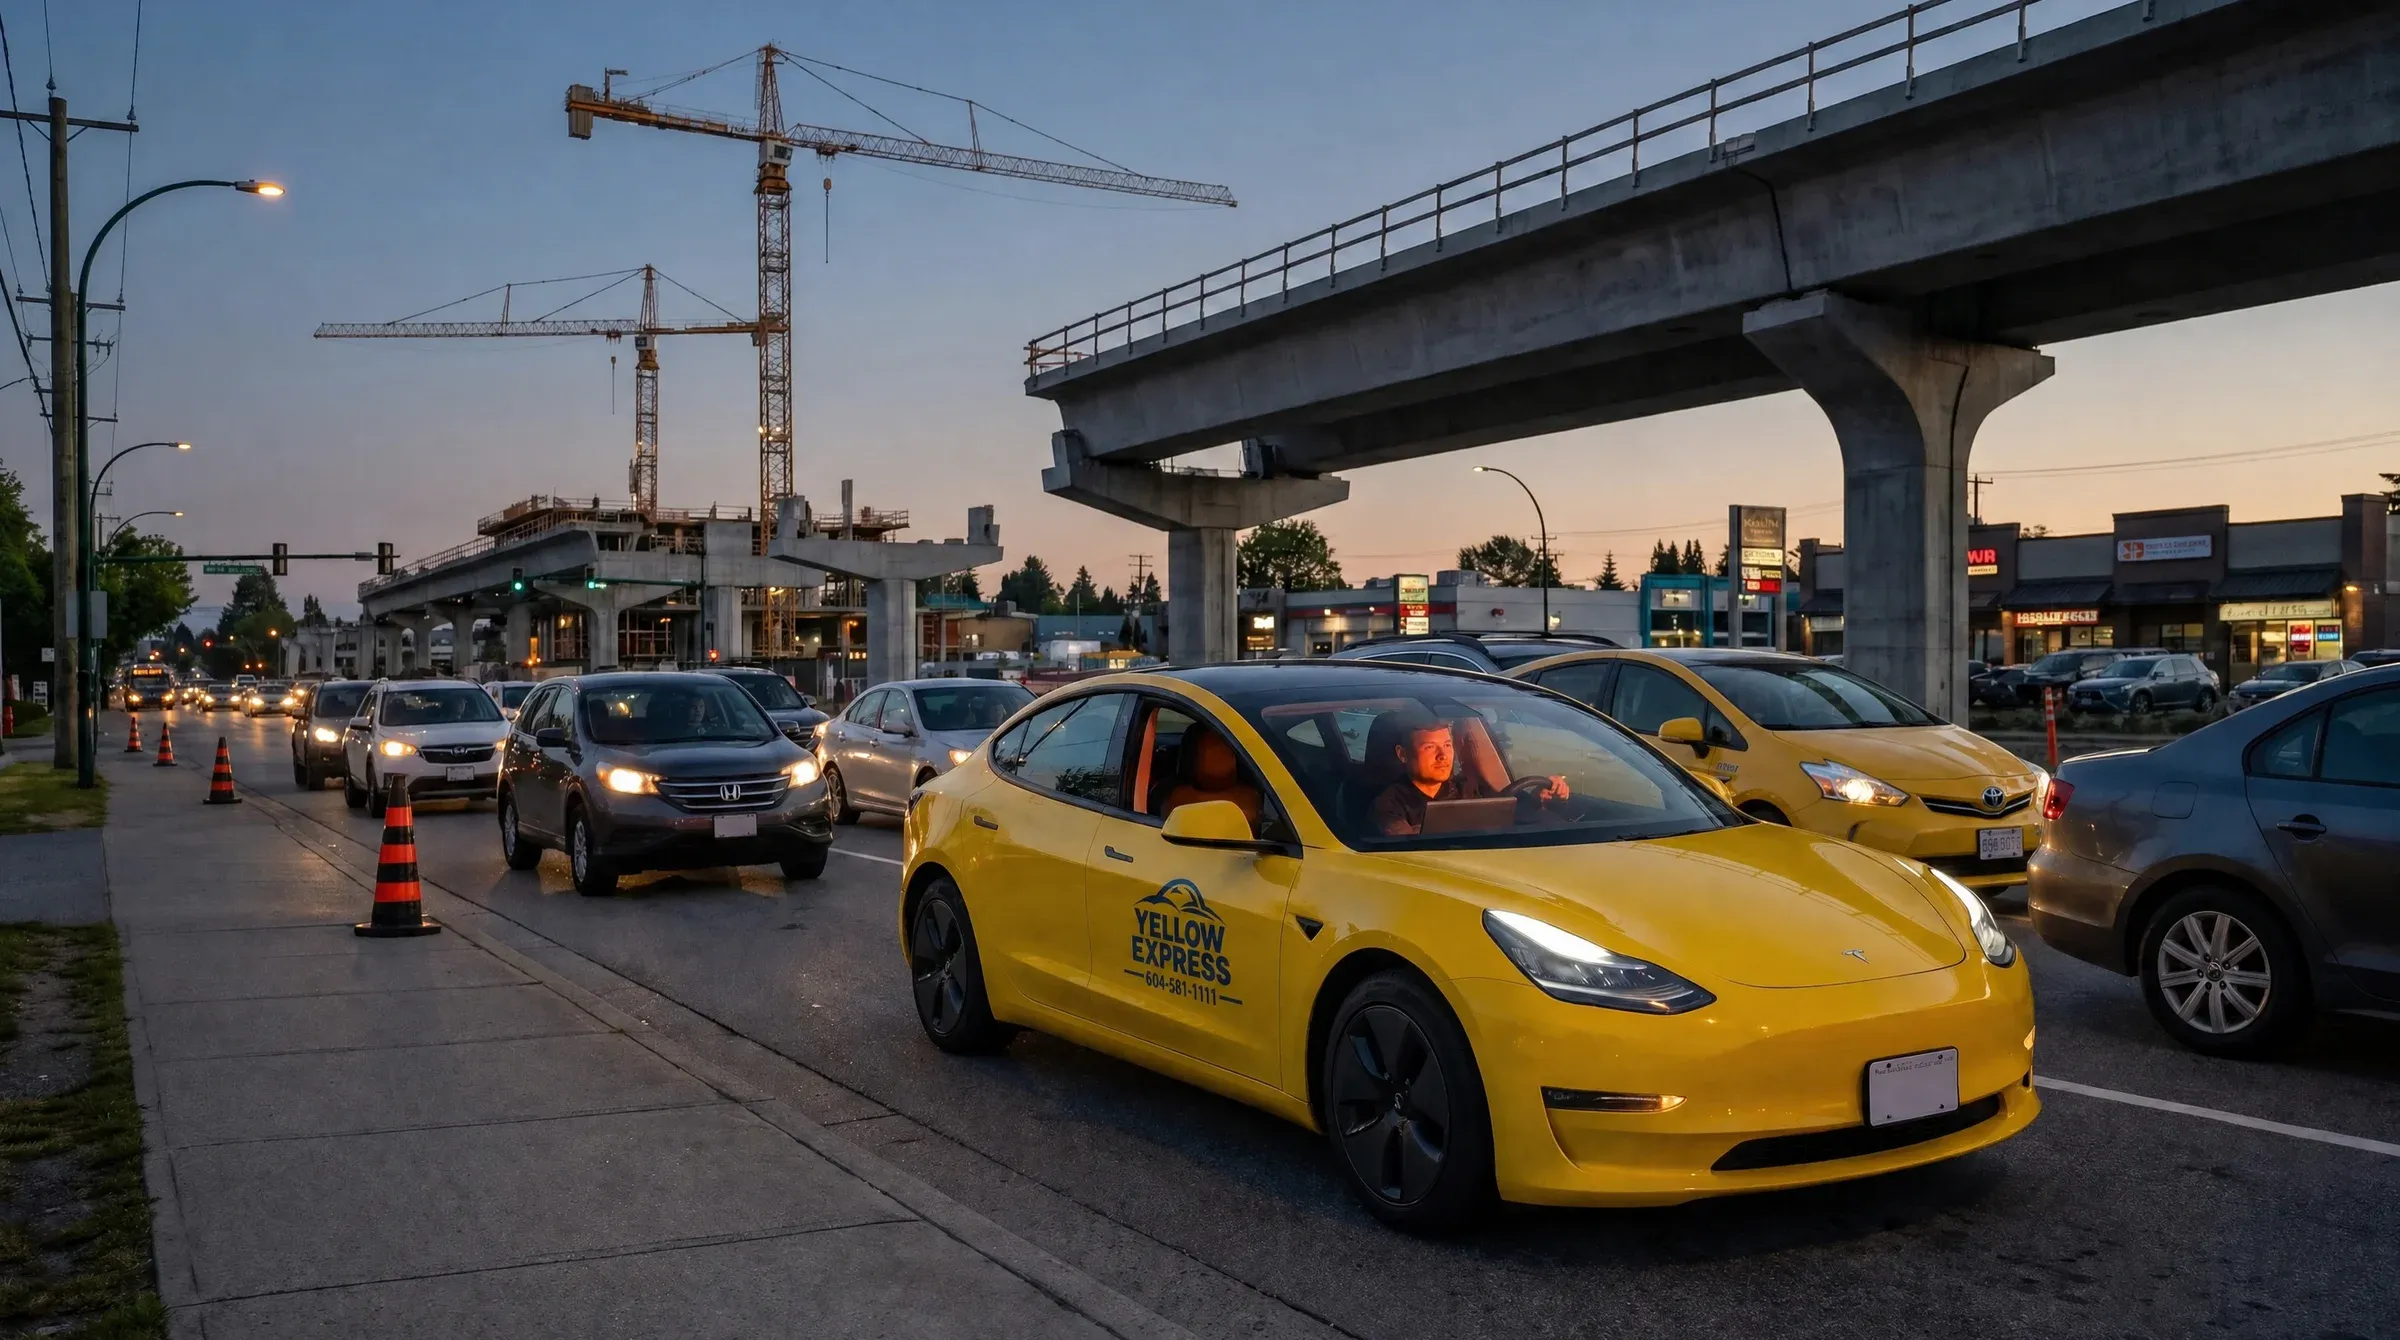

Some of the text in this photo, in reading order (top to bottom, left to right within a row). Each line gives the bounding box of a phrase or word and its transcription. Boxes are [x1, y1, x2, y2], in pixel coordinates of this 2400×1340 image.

[1134, 908, 1226, 954] YELLOW
[1131, 935, 1232, 986] EXPRESS
[1145, 970, 1217, 1006] 604-581-1111
